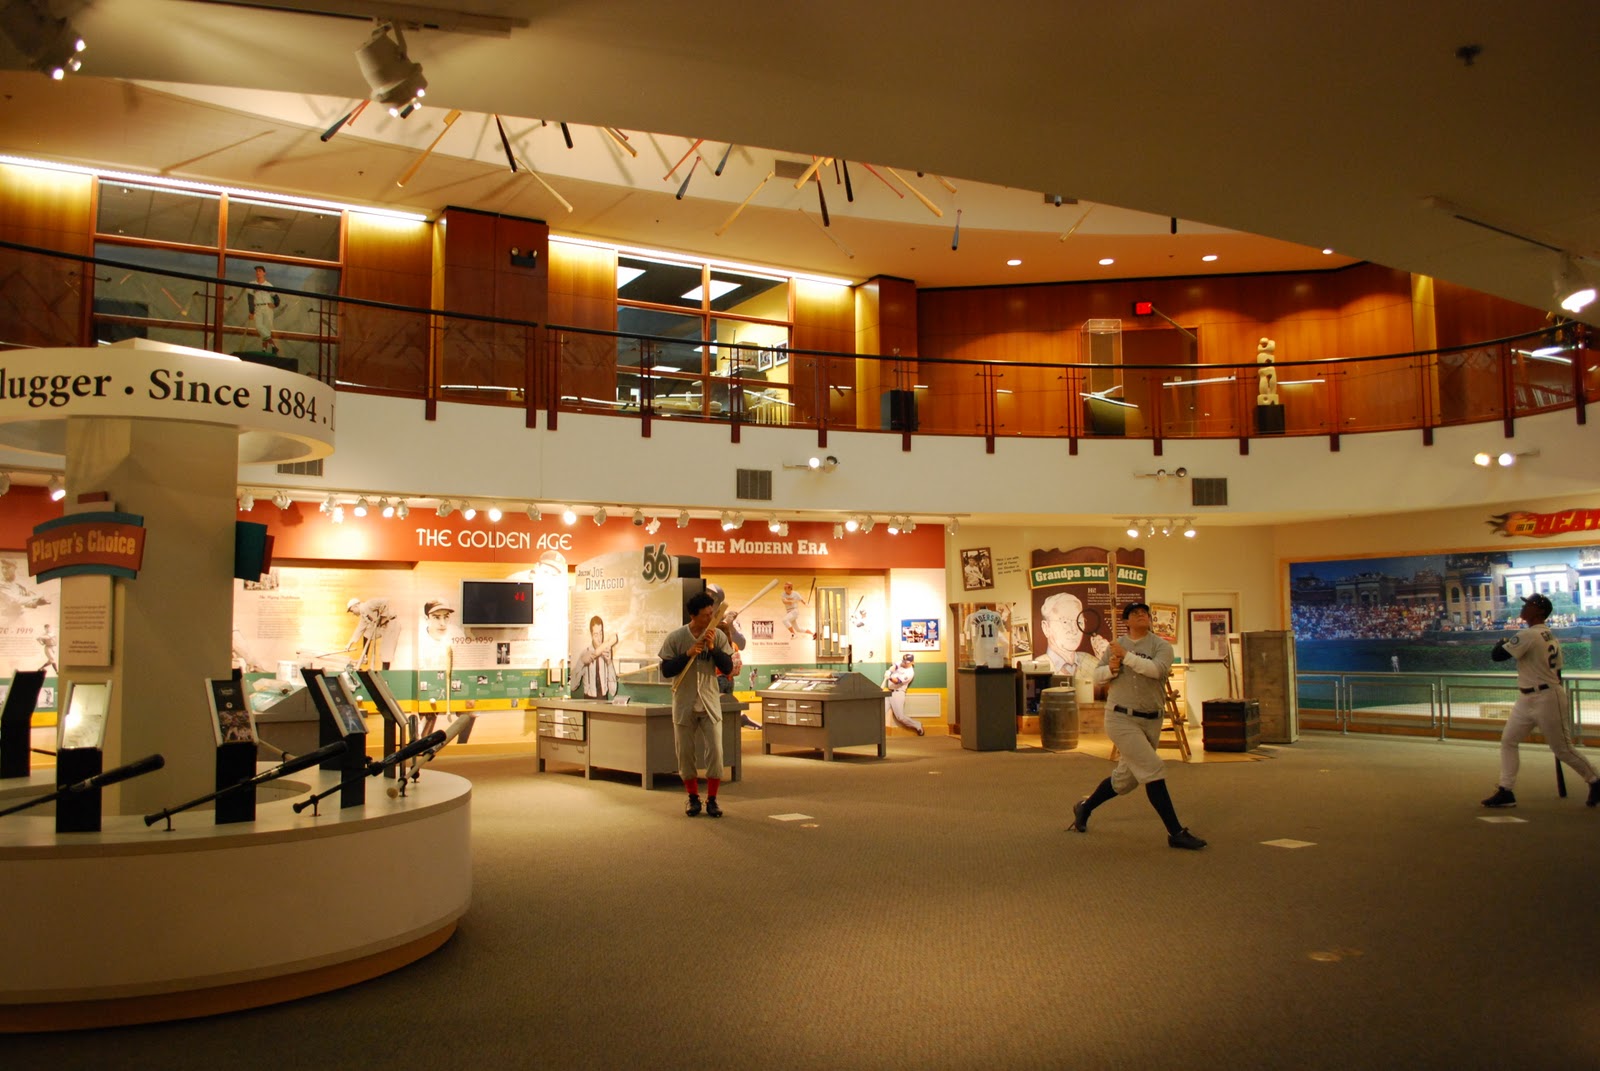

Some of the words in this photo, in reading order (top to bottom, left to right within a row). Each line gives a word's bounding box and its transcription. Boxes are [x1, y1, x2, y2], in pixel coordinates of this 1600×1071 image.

[148, 368, 250, 408] Since
[262, 385, 317, 424] 1884
[32, 531, 84, 563] Player's
[87, 530, 136, 555] Choice
[415, 528, 452, 547] THE
[457, 530, 531, 549] GOLDEN
[536, 532, 573, 551] AGE
[693, 537, 726, 554] THE
[729, 538, 794, 555] MODERN
[797, 539, 829, 555] ERA
[641, 542, 671, 583] 56
[1035, 568, 1081, 582] Grandpa
[1083, 566, 1108, 578] Bud'
[1117, 568, 1144, 581] Attic
[981, 624, 993, 638] 11
